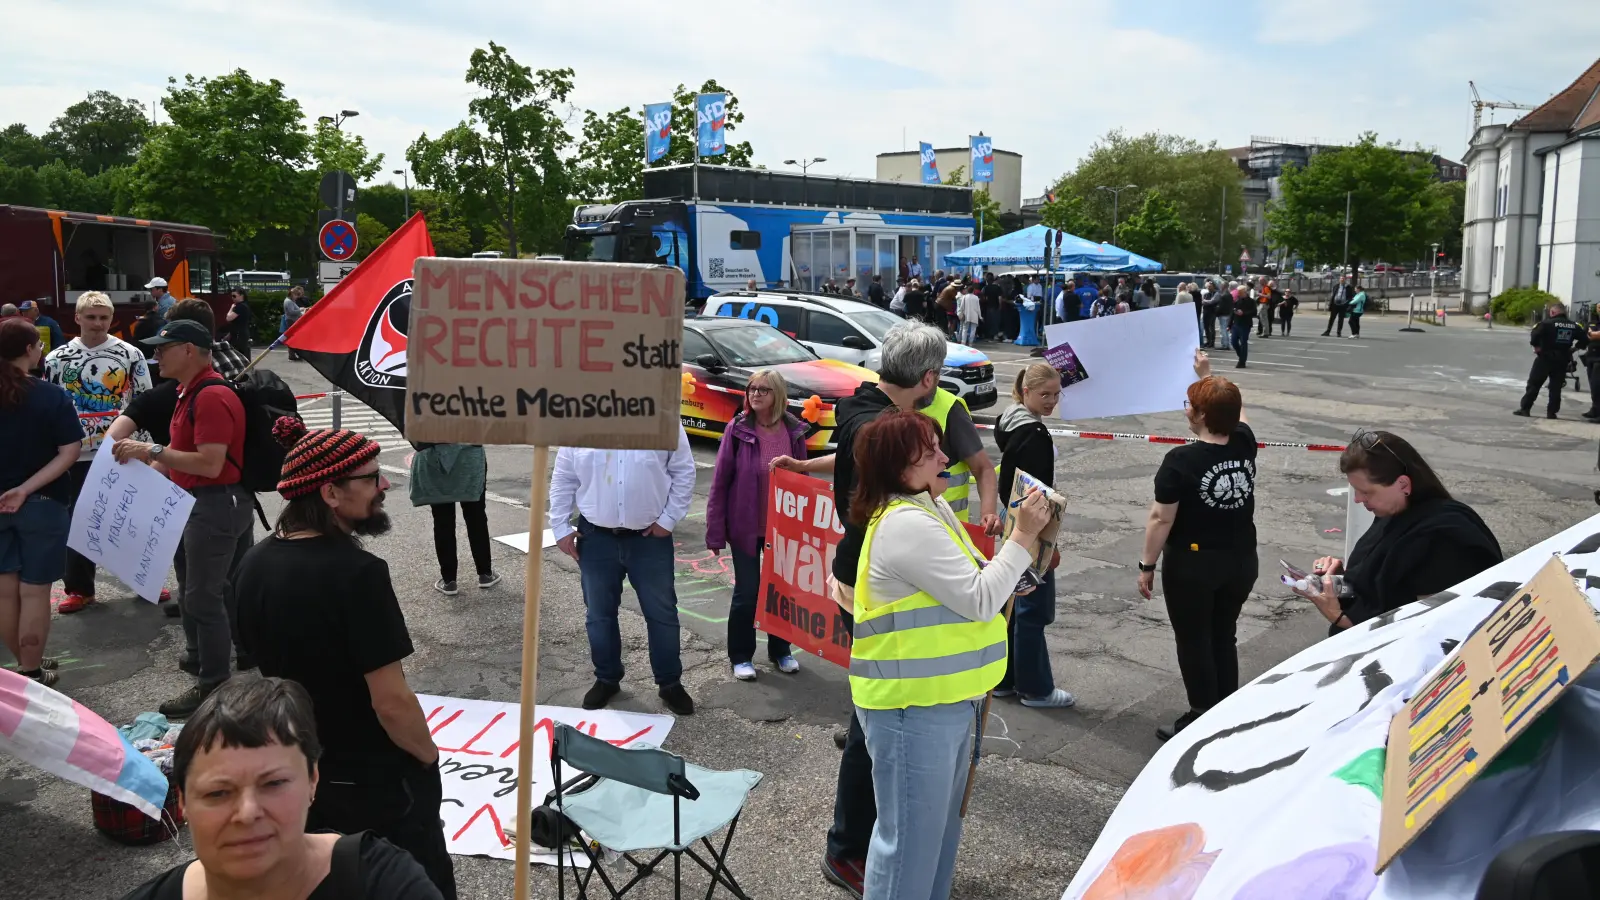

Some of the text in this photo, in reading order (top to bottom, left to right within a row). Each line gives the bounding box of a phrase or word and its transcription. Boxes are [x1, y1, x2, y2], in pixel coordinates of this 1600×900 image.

[646, 110, 671, 136] AfD
[697, 101, 725, 128] AfD
[921, 148, 936, 165] AfD
[971, 142, 992, 160] AfD
[420, 267, 675, 318] MENSCHEN
[416, 315, 680, 372] RECHTE statt
[358, 360, 391, 385] AKTION
[412, 386, 655, 418] rechte Menschen
[681, 399, 704, 410] enburg
[682, 417, 707, 429] ach.de
[1199, 470, 1215, 491] HIRN
[1212, 460, 1240, 474] GEGEN
[86, 528, 103, 556] DIE
[101, 468, 120, 490] DES
[107, 484, 138, 549] MENSCHEN
[127, 518, 138, 539] IST
[765, 582, 826, 640] keine
[1496, 615, 1569, 733] VIELFALT
